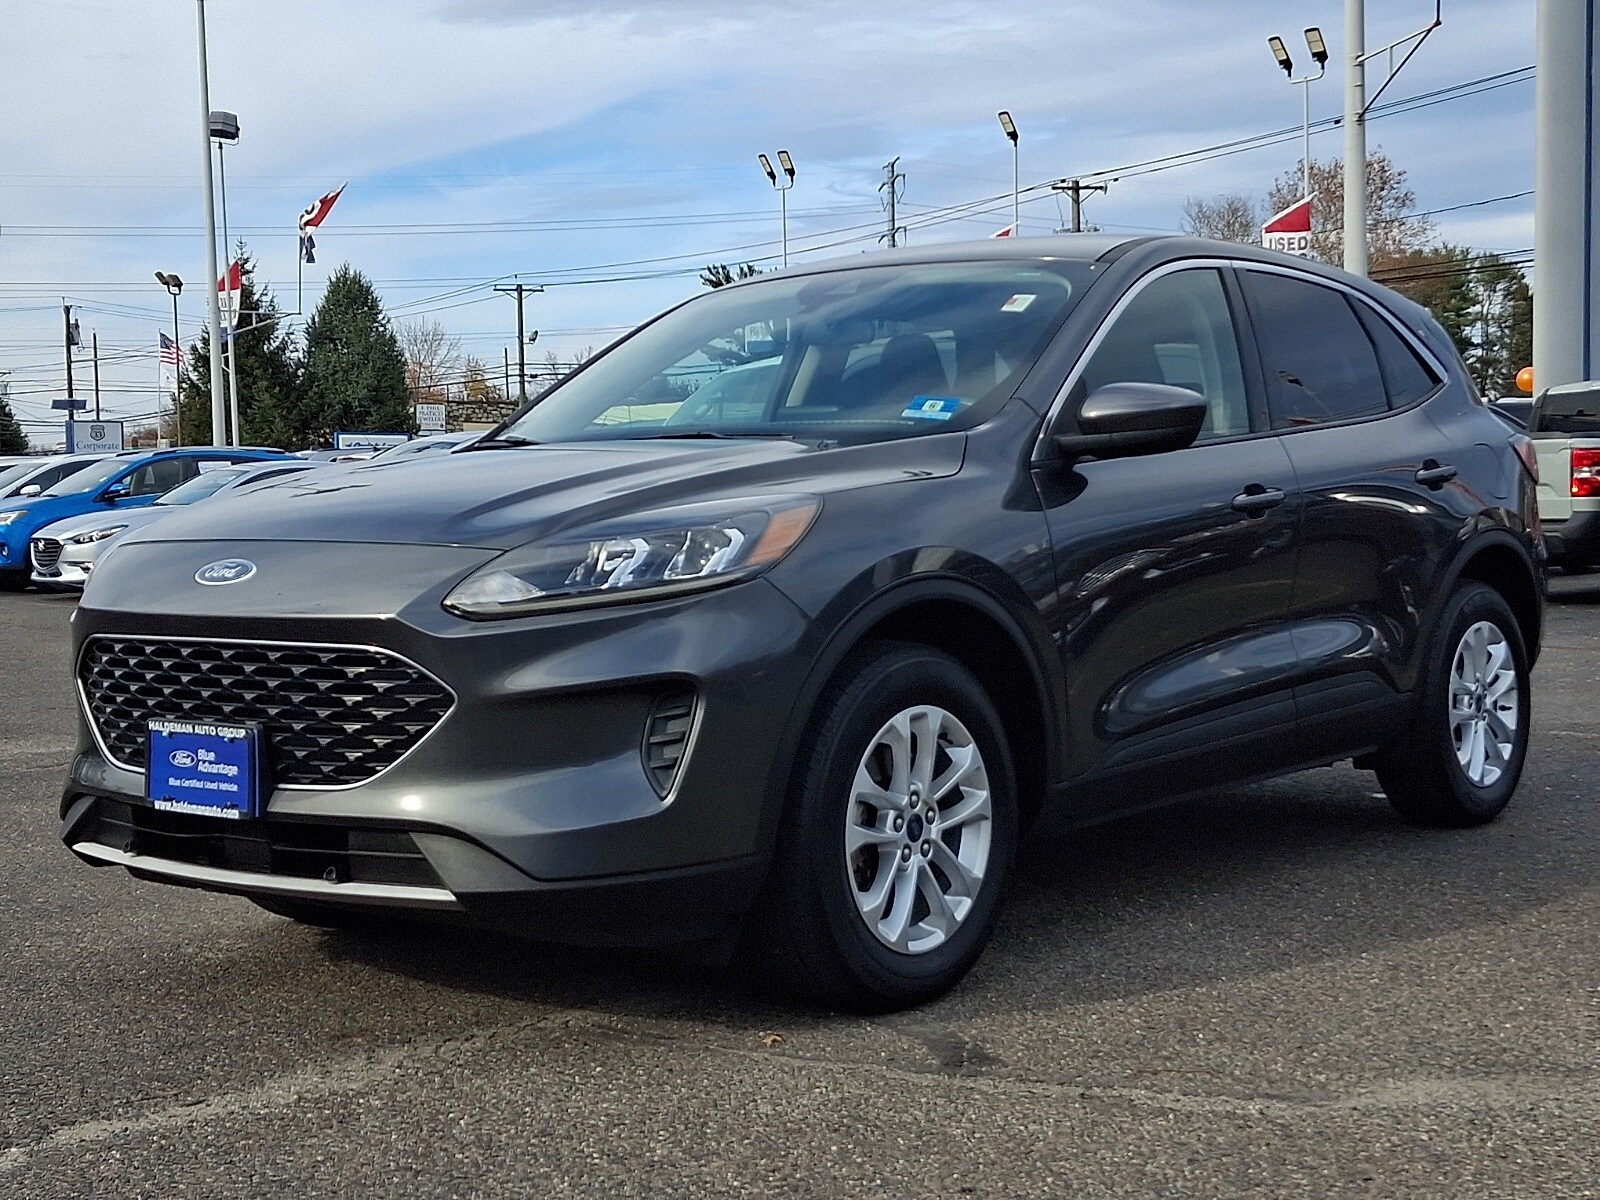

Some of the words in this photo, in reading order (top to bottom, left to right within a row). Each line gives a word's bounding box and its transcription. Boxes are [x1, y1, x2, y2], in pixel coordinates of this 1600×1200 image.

[1269, 236, 1308, 251] USED
[76, 441, 120, 451] Corporate
[204, 562, 242, 578] Ford
[148, 720, 194, 733] HALDEMAN
[194, 724, 216, 736] AUTO
[217, 726, 246, 739] GROUP
[173, 752, 192, 765] Ford
[197, 748, 216, 760] Blue
[197, 761, 239, 776] Advantage
[181, 778, 203, 788] Certified
[204, 780, 218, 790] Used
[218, 782, 238, 792] Vehicle
[154, 800, 239, 819] www.haldemanauto.com
